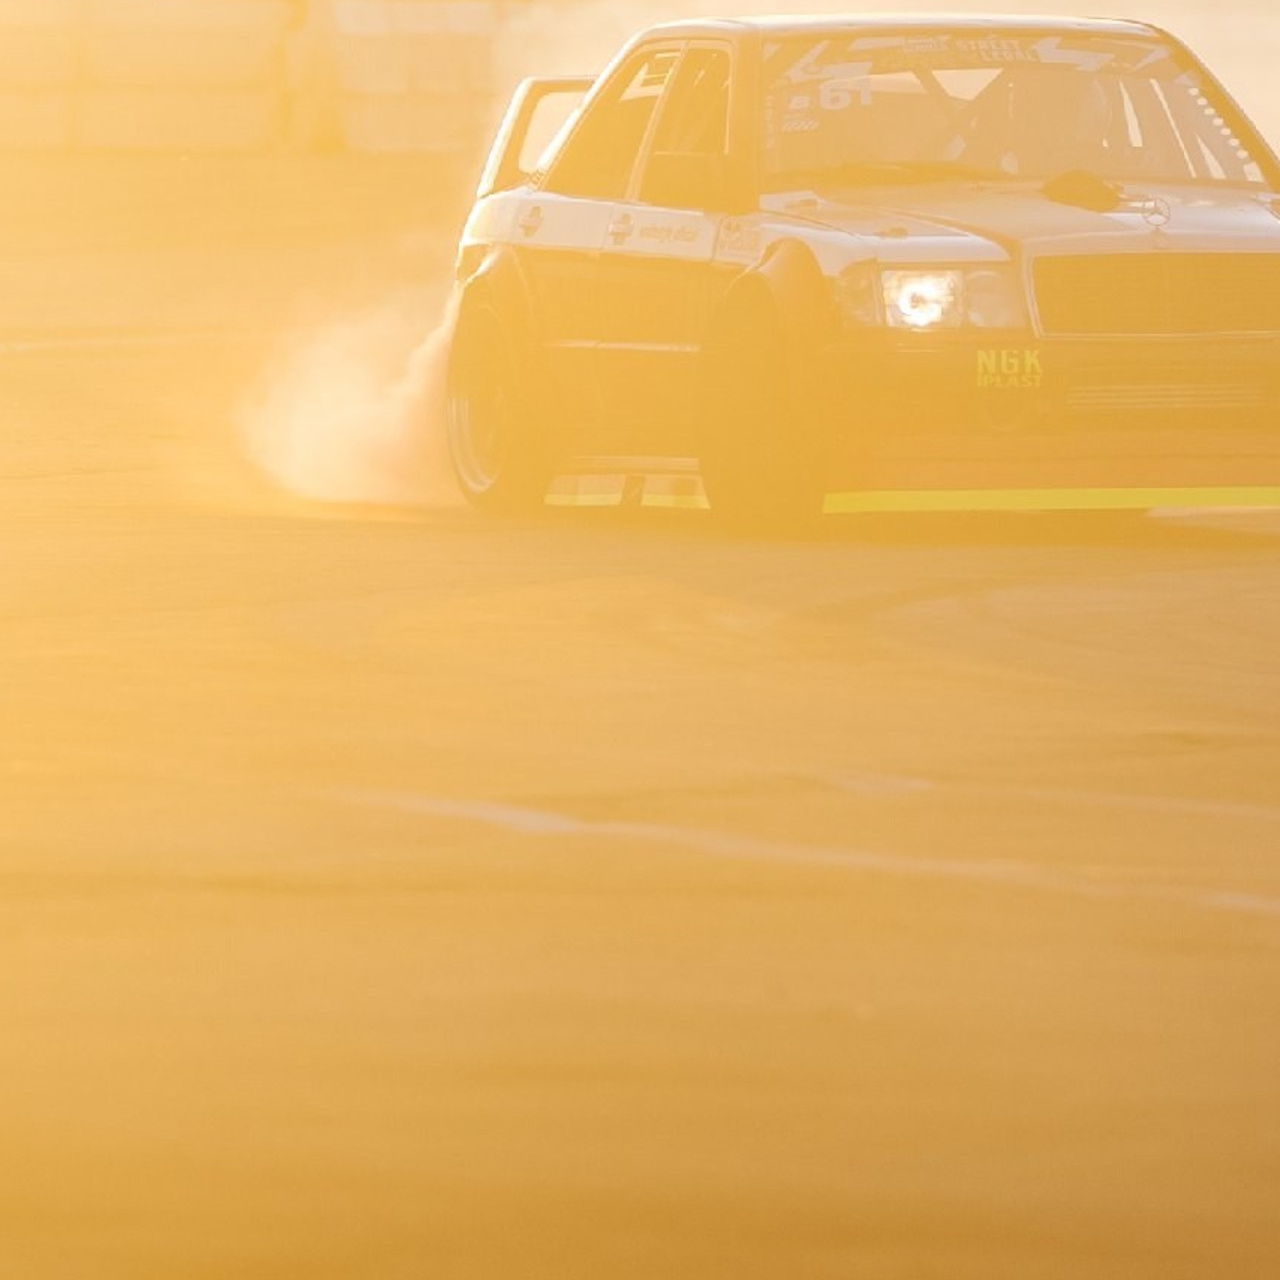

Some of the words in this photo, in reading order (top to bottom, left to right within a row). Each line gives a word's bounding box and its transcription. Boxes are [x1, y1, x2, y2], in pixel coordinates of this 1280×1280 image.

[954, 38, 1019, 51] STREET
[979, 49, 1039, 62] LEGAL
[818, 78, 873, 111] 61
[976, 349, 1044, 374] NGK
